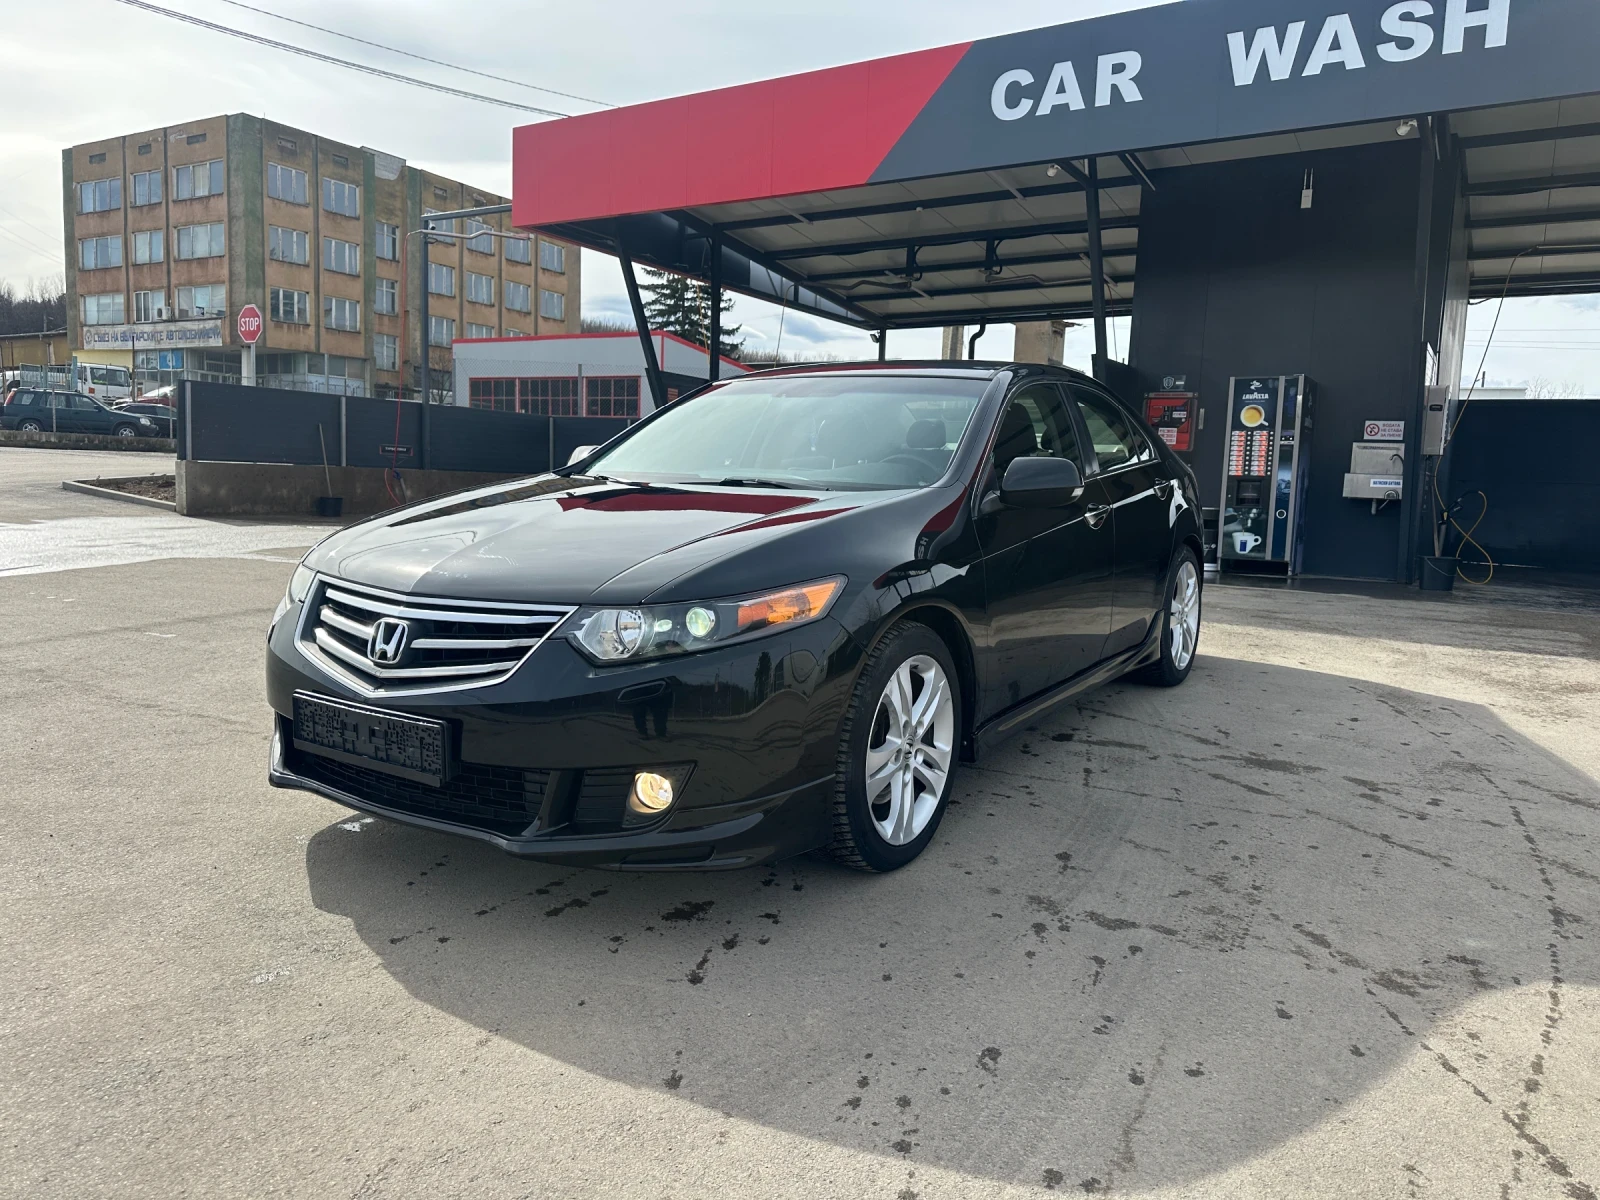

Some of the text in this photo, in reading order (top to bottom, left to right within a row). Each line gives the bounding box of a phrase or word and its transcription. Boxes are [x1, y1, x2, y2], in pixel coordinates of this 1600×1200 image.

[990, 0, 1511, 121] CAR WASH
[240, 317, 260, 331] STOP
[110, 331, 119, 342] НА
